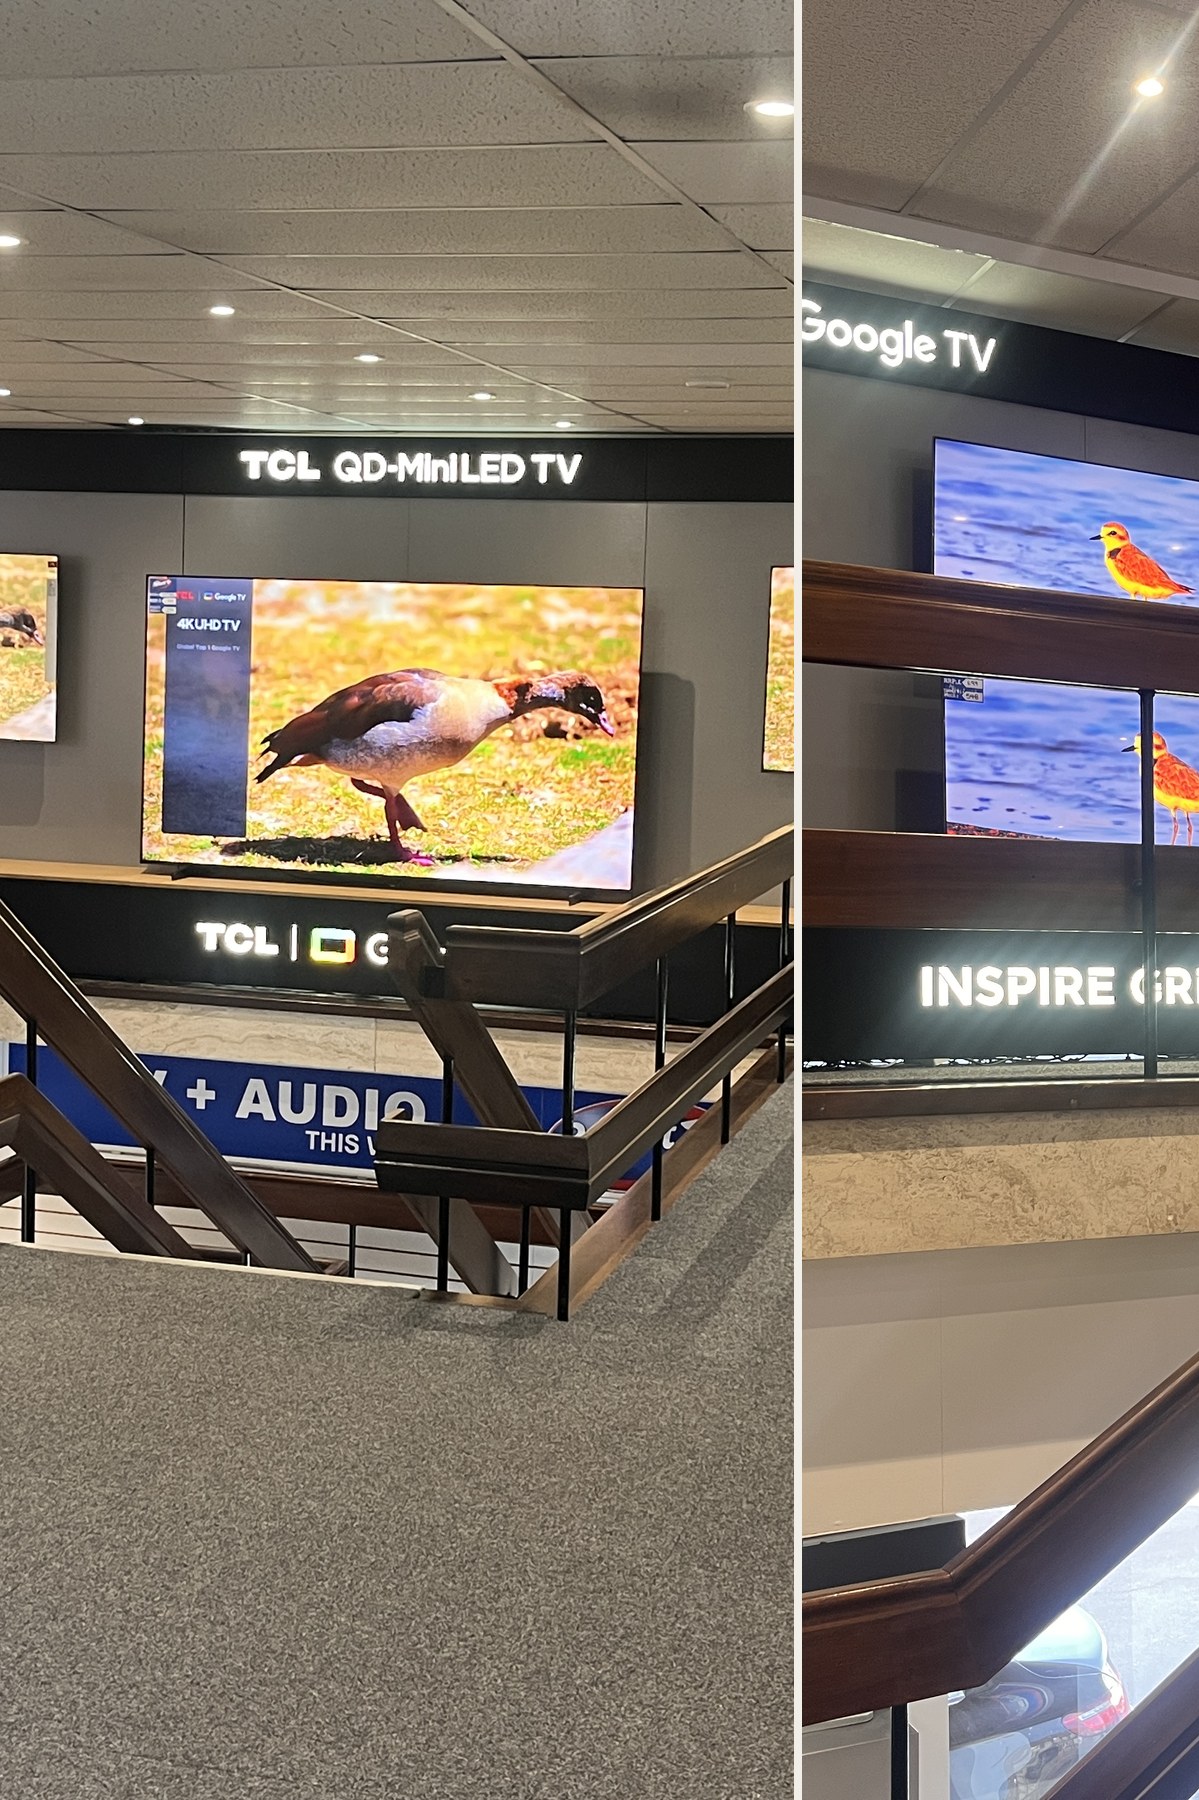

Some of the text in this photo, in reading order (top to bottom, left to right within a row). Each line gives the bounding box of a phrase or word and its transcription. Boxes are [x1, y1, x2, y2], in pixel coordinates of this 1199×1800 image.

[802, 299, 996, 372] Google TV
[239, 450, 321, 480] TCL
[531, 453, 582, 484] TV
[195, 922, 280, 955] TCL
[919, 965, 1116, 1007] INSPIRE
[305, 1130, 360, 1155] THIS
